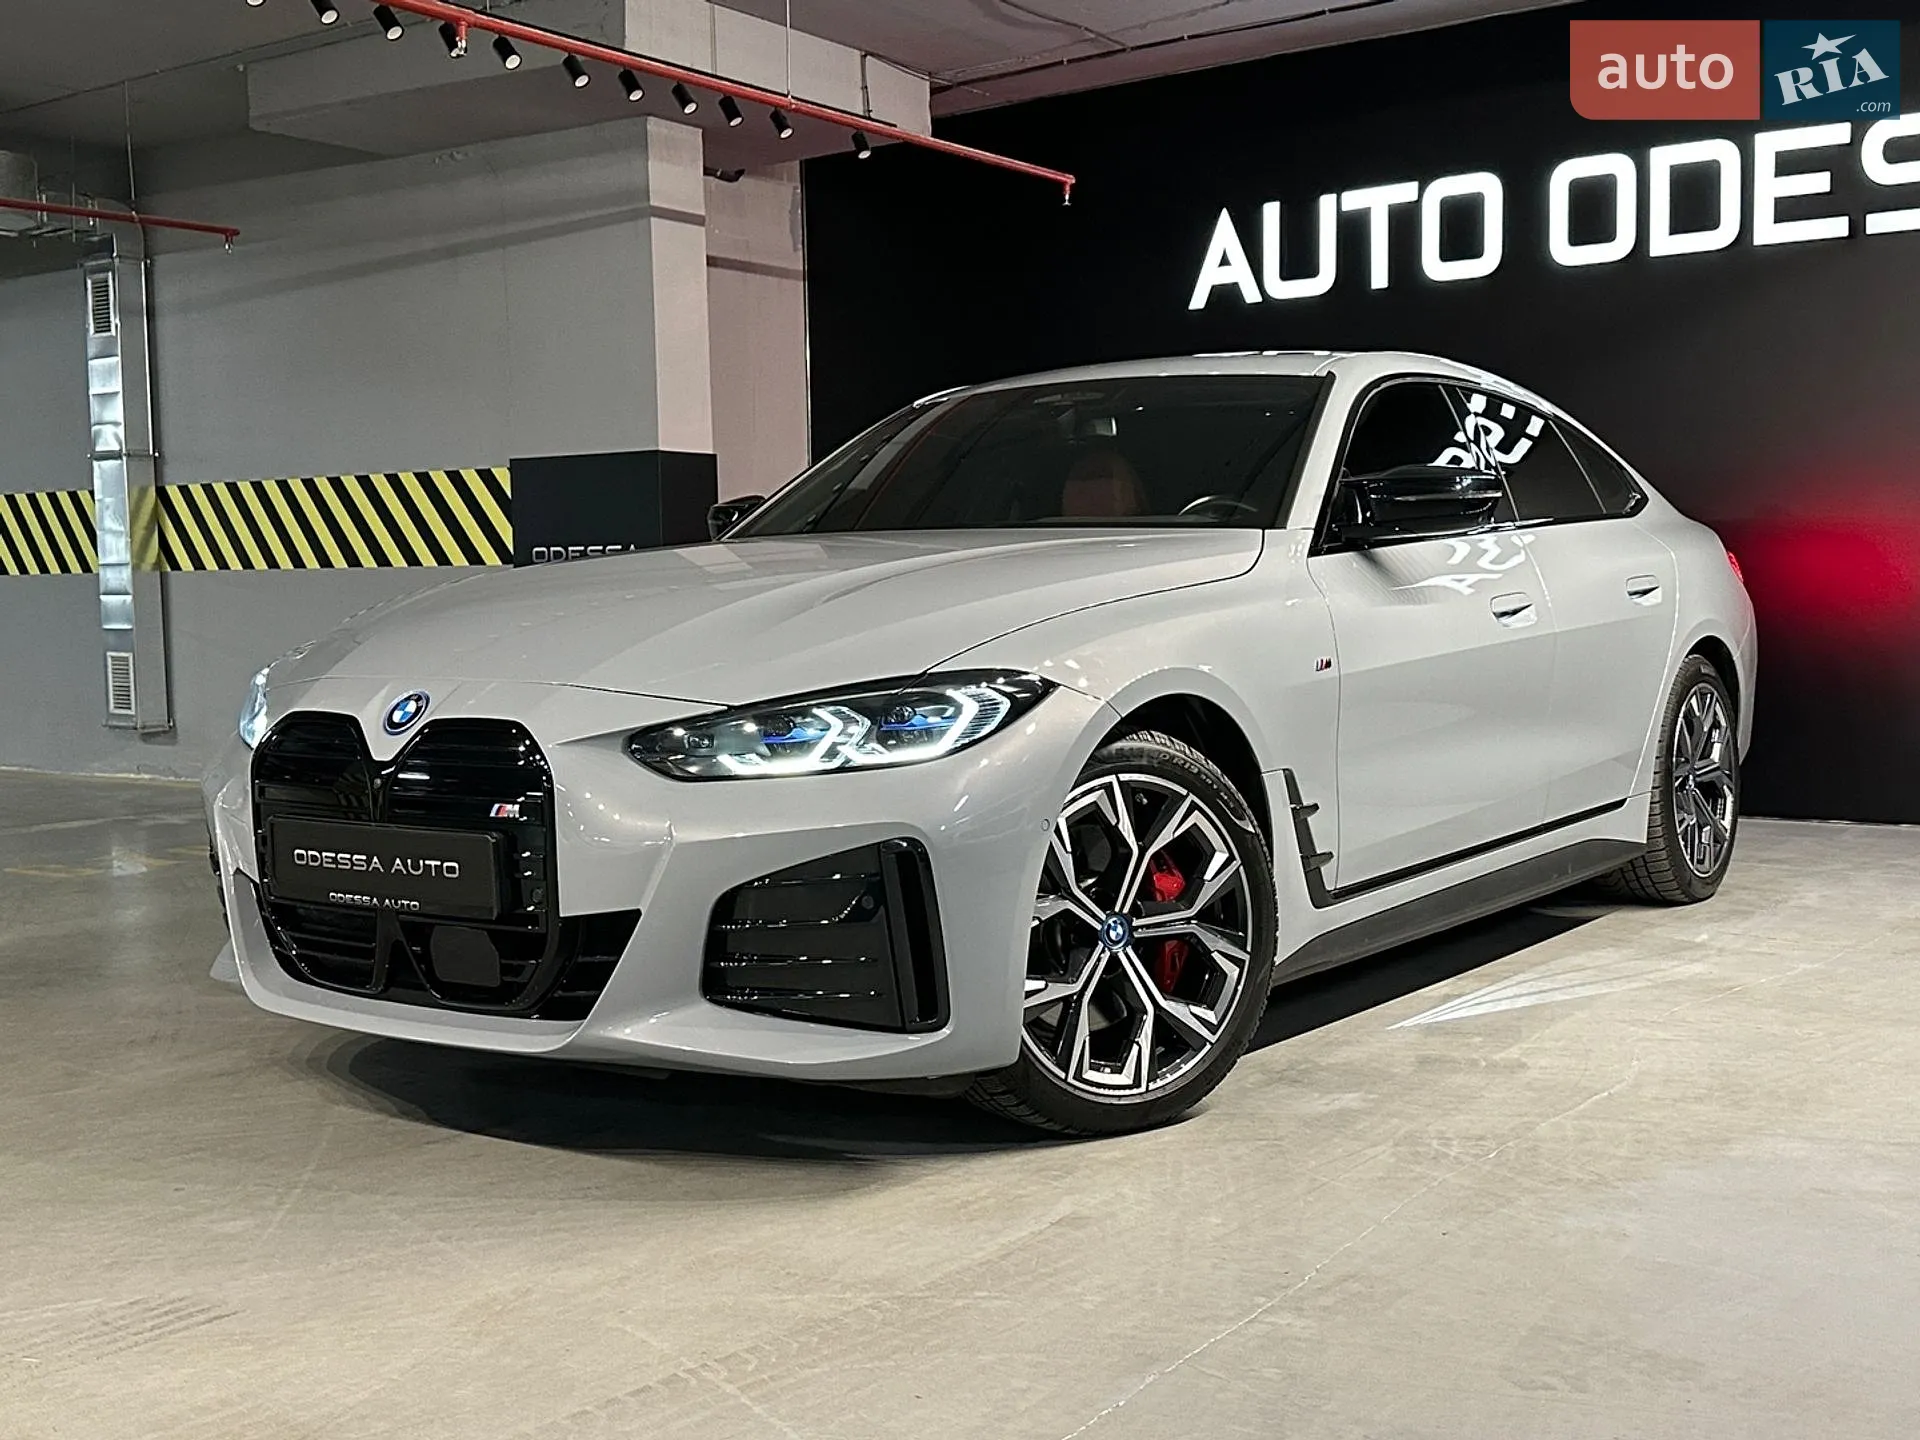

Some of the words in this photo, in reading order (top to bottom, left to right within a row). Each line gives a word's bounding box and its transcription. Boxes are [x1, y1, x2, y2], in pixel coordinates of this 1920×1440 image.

[1188, 171, 1504, 310] AUTO
[294, 848, 385, 873] ODESSA
[391, 857, 460, 878] AUTO
[329, 892, 380, 907] ODESSA
[383, 898, 420, 911] AUTO
